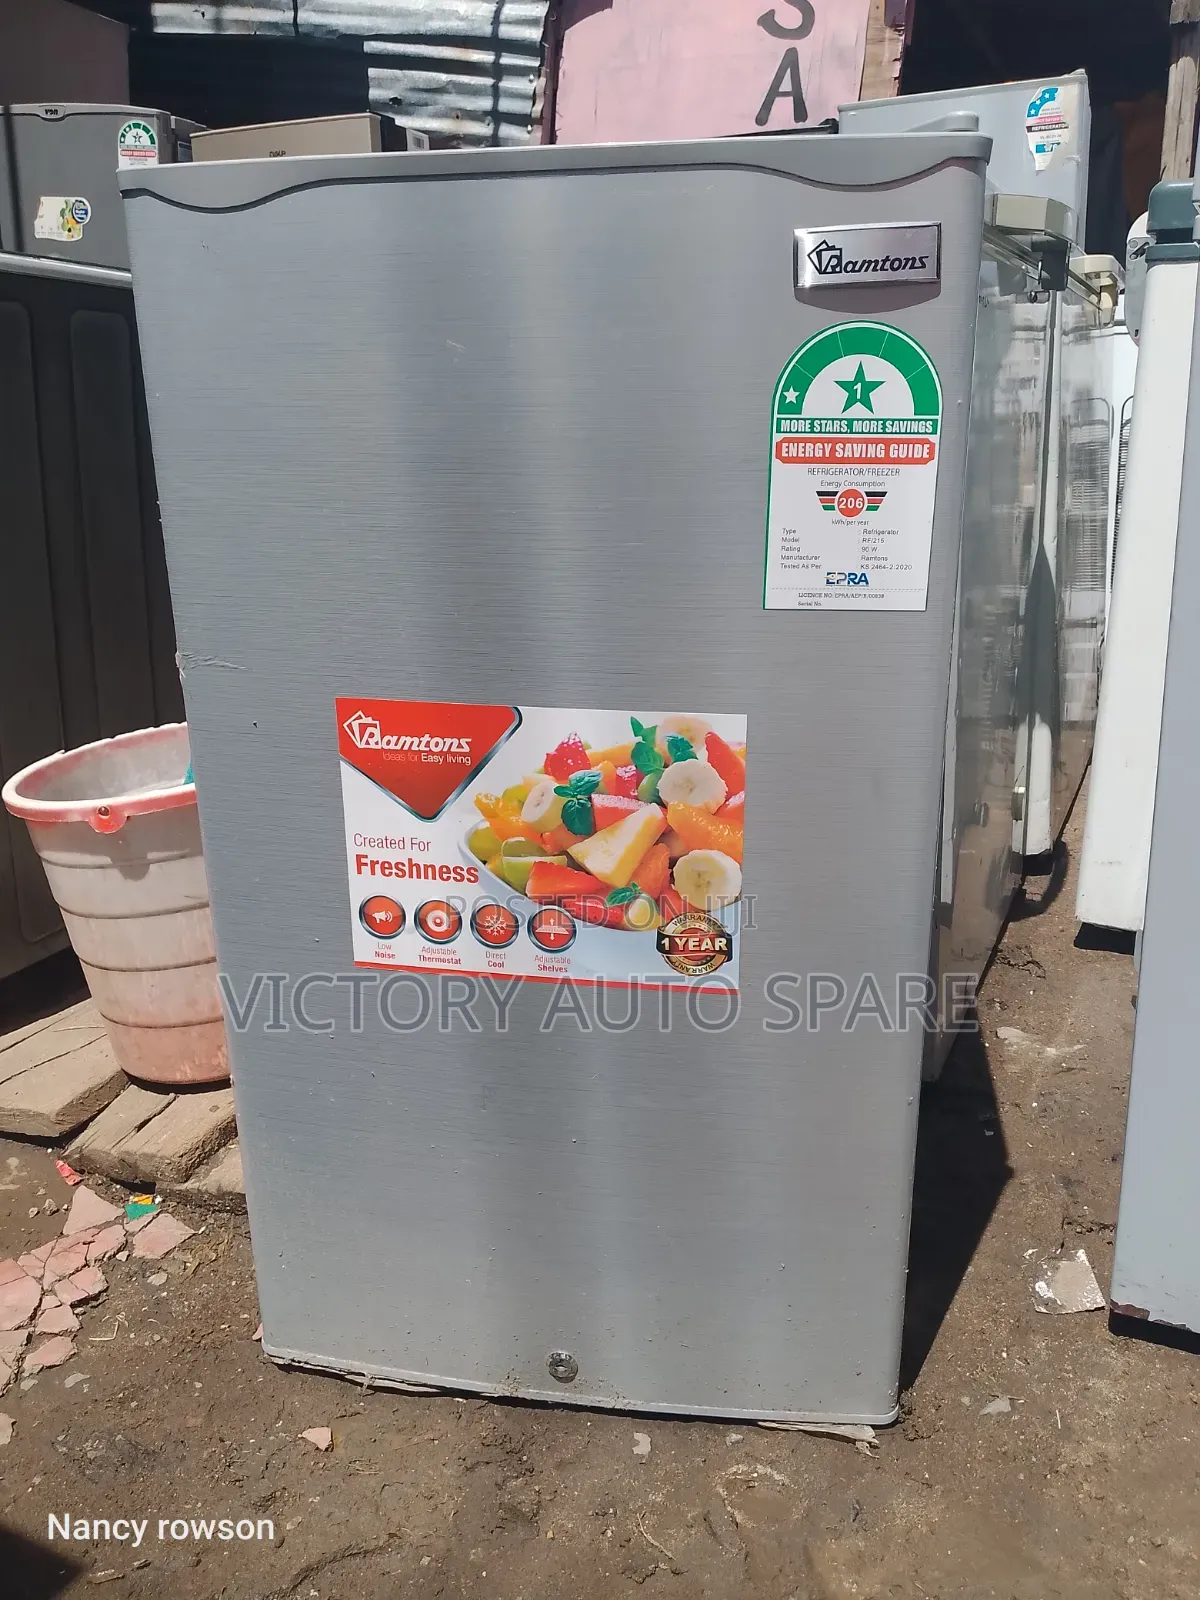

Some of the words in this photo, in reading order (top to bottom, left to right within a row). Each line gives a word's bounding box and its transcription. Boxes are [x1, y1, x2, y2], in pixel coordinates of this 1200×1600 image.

[818, 250, 929, 274] Ramtons
[853, 382, 862, 399] 1
[780, 420, 811, 432] MORE
[813, 420, 850, 433] STARS,
[853, 420, 883, 433] MORE
[885, 420, 933, 433] SAVINGS
[781, 442, 832, 457] ENERGY
[835, 443, 885, 458] SAVING
[889, 444, 930, 459] GUIDE
[807, 467, 900, 476] REFRIGERATOR/FREEZER
[843, 480, 885, 488] Consumption
[838, 498, 864, 509] 206
[862, 528, 899, 536] Refrigerator
[781, 545, 801, 553] Rating
[825, 572, 870, 585] EPRA
[358, 722, 472, 752] Ramtons
[382, 751, 406, 762] Ideas
[407, 751, 419, 762] for
[421, 752, 444, 765] Easy
[447, 753, 471, 766] living
[353, 832, 406, 850] Created
[410, 837, 431, 852] For
[355, 853, 479, 884] Freshness
[377, 942, 392, 950] Low
[661, 937, 670, 950] 1
[674, 937, 728, 951] YEAR
[374, 950, 396, 959] Noise
[421, 945, 457, 956] Adjustable
[485, 950, 506, 960] Direct
[418, 954, 462, 965] Thermostat
[487, 960, 505, 968] Cool
[534, 954, 571, 965] Adjustable
[537, 963, 568, 973] Shelves
